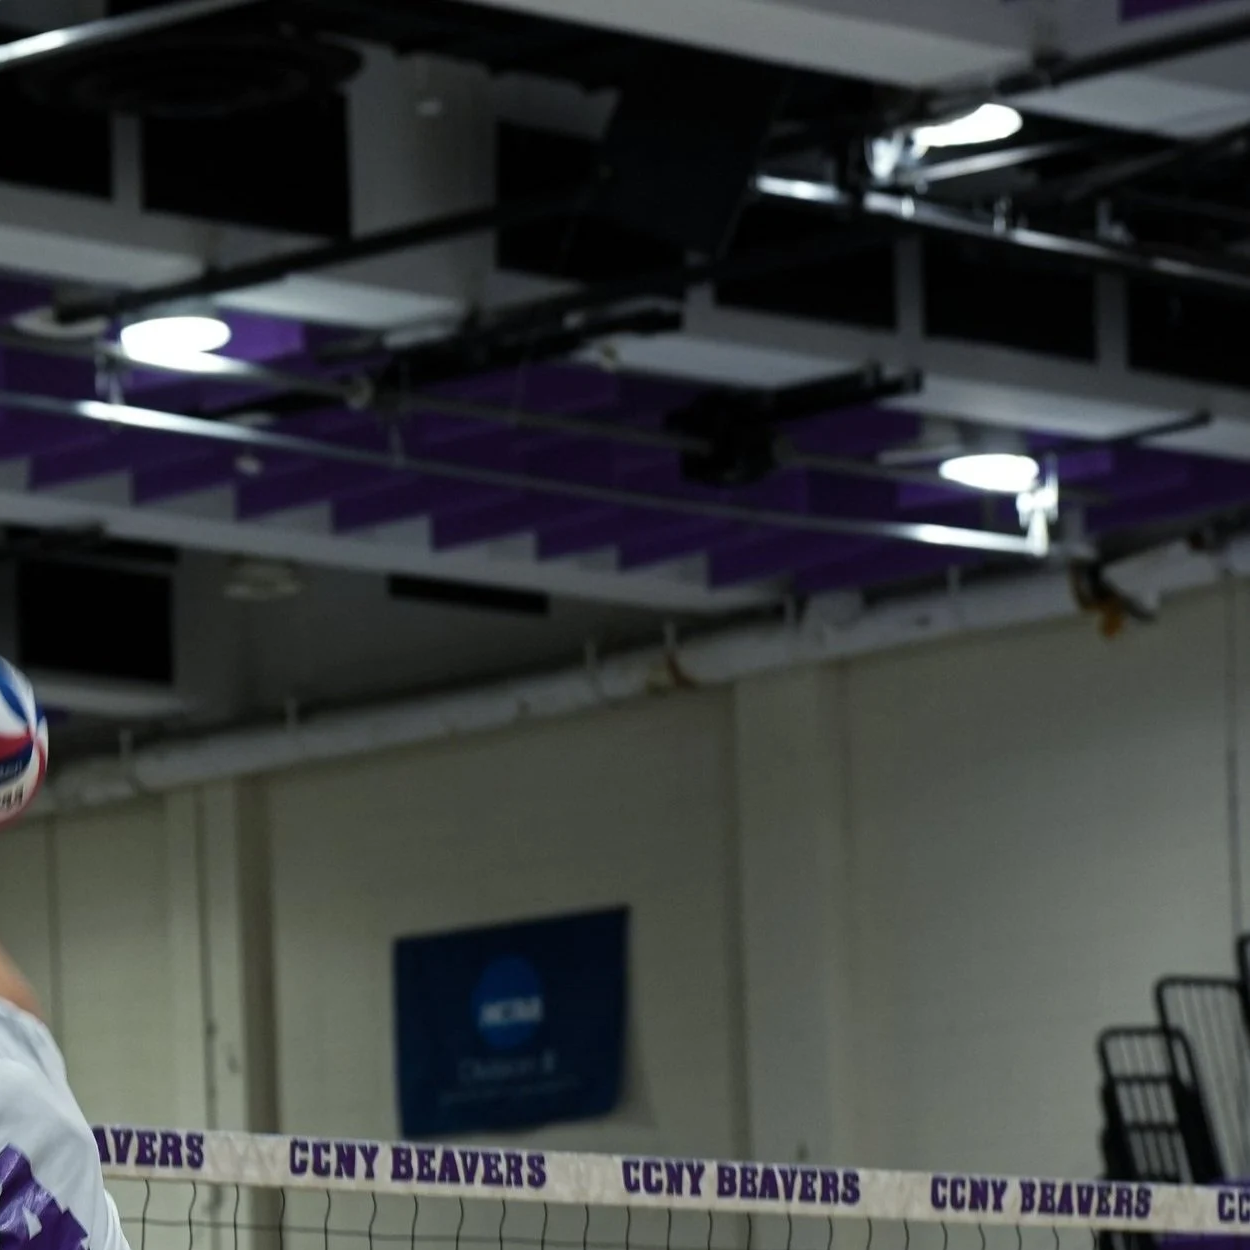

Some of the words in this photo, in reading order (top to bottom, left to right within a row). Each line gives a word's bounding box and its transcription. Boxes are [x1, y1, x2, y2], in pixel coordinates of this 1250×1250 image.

[92, 1126, 204, 1170] AVERS
[290, 1139, 379, 1179] CCNY
[391, 1145, 547, 1188] BEAVERS
[622, 1160, 705, 1196] CCNY
[717, 1163, 860, 1205] BEAVERS
[931, 1176, 1007, 1213] CCNY
[1020, 1181, 1152, 1219] BEAVERS
[1218, 1192, 1250, 1222] CC
